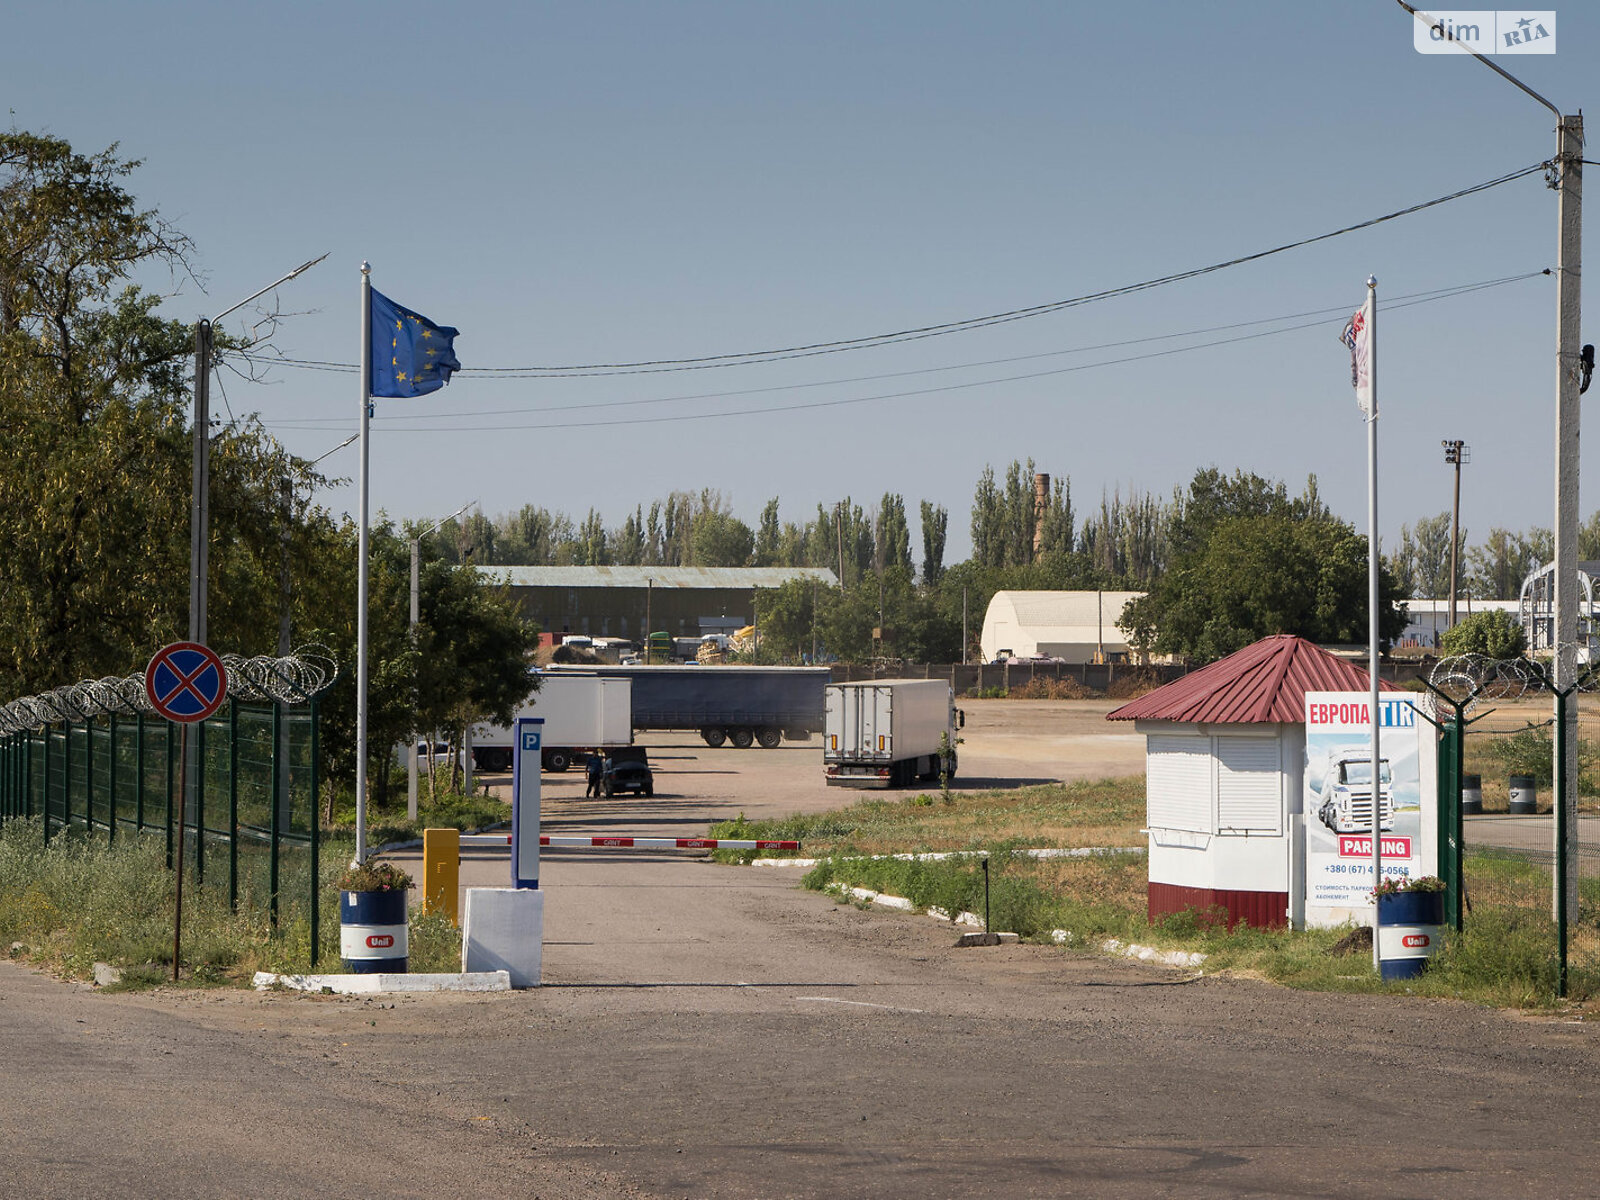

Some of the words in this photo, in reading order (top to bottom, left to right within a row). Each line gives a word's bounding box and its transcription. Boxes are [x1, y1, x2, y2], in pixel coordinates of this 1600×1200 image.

[1310, 703, 1370, 724] ЕВРОПА
[1379, 702, 1413, 726] TIR
[526, 734, 537, 749] P
[1344, 840, 1405, 855] PARING
[1325, 864, 1346, 873] +380
[1348, 865, 1366, 874] (67)
[371, 937, 389, 946] Unil
